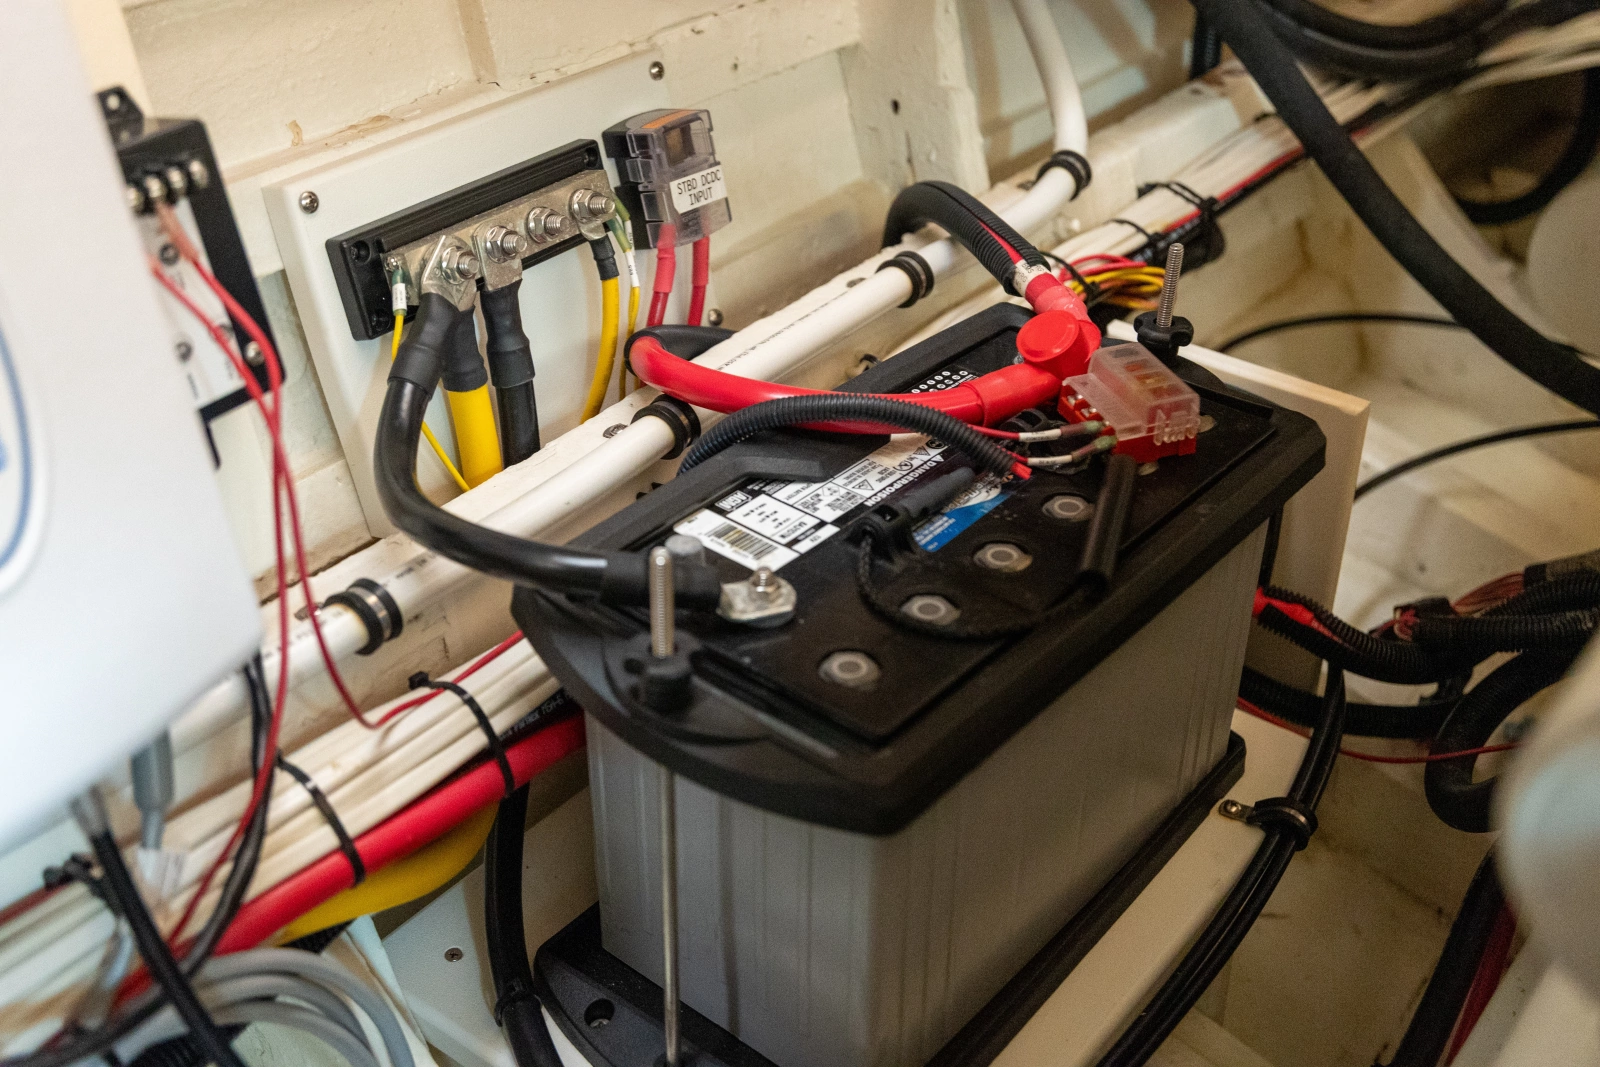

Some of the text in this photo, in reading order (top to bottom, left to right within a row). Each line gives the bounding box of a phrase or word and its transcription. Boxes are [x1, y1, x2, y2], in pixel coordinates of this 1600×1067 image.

[677, 169, 721, 195] STBD DCDC
[688, 187, 713, 205] INPUT
[864, 459, 936, 507] DANGER/POISON
[718, 492, 748, 509] AGM
